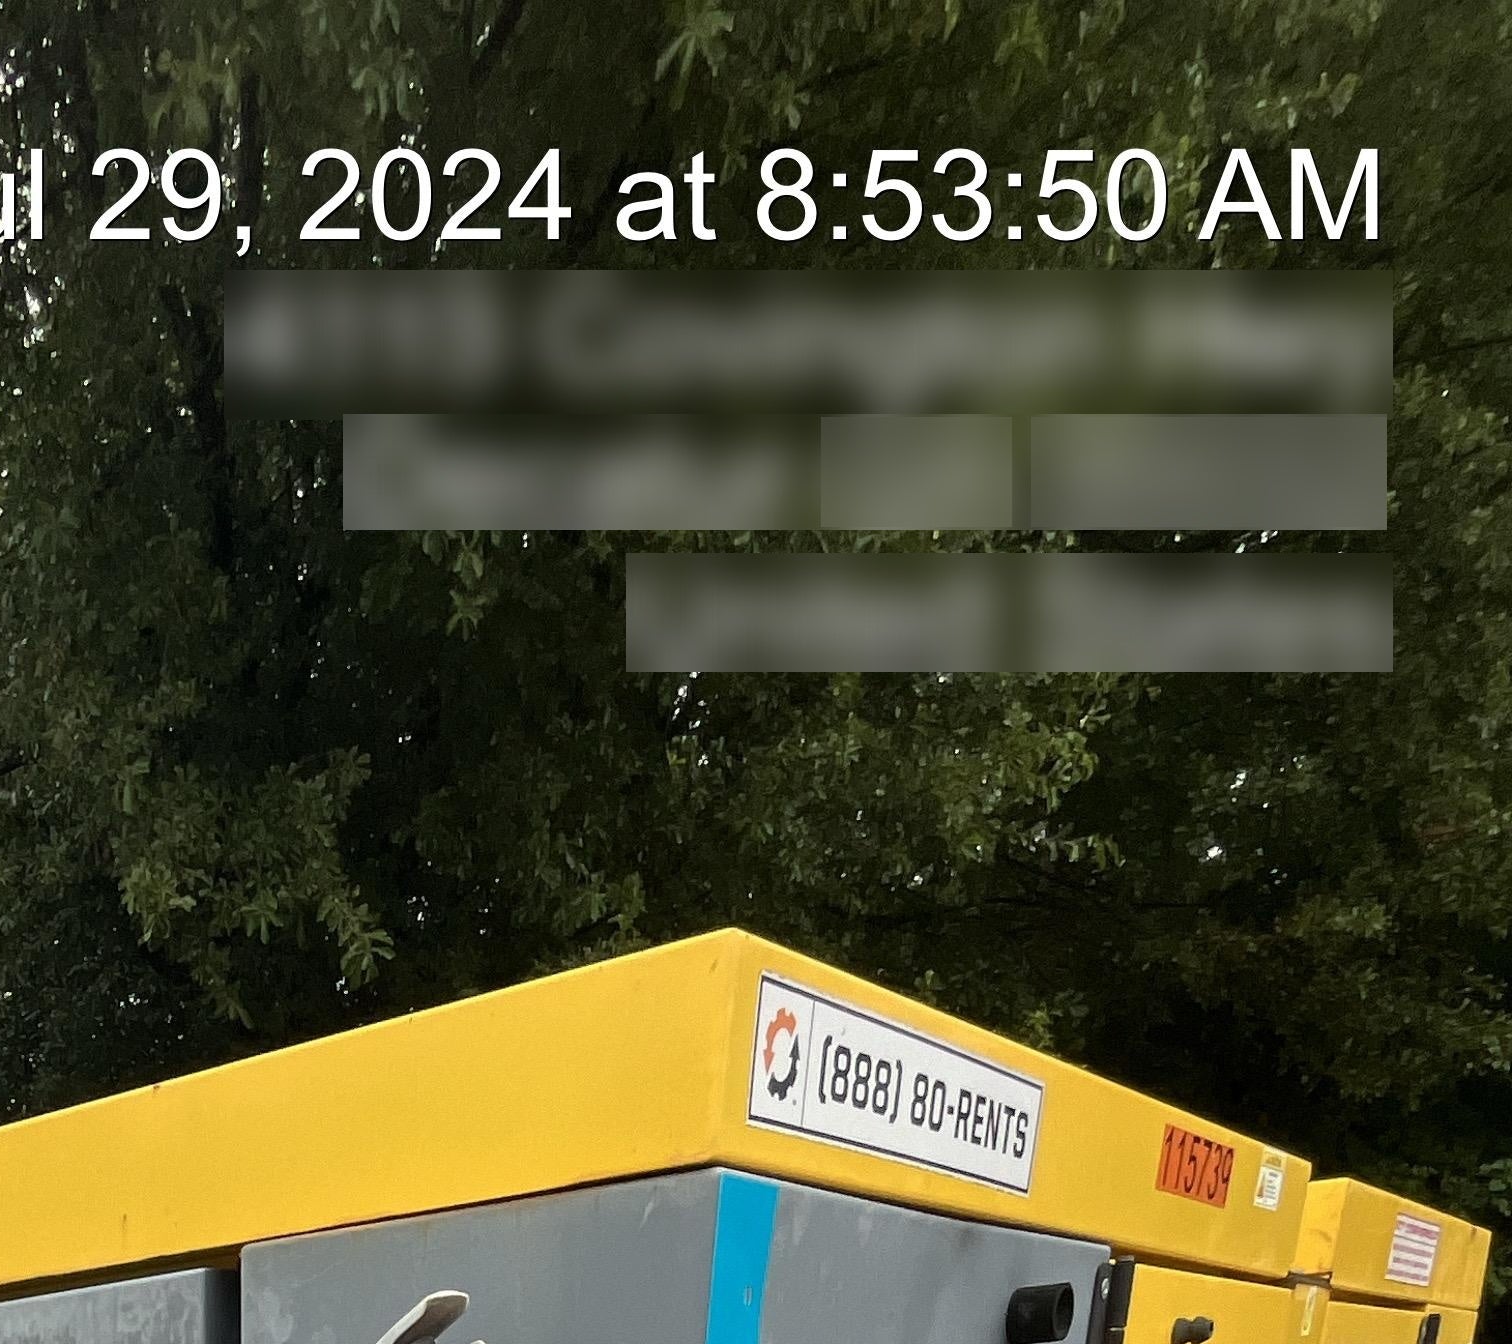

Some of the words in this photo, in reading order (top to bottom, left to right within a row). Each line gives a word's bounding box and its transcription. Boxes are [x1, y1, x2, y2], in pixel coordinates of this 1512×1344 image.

[818, 1035, 903, 1124] (888)
[910, 1073, 1029, 1159] 80-RENTS
[1162, 1125, 1234, 1200] 115739
